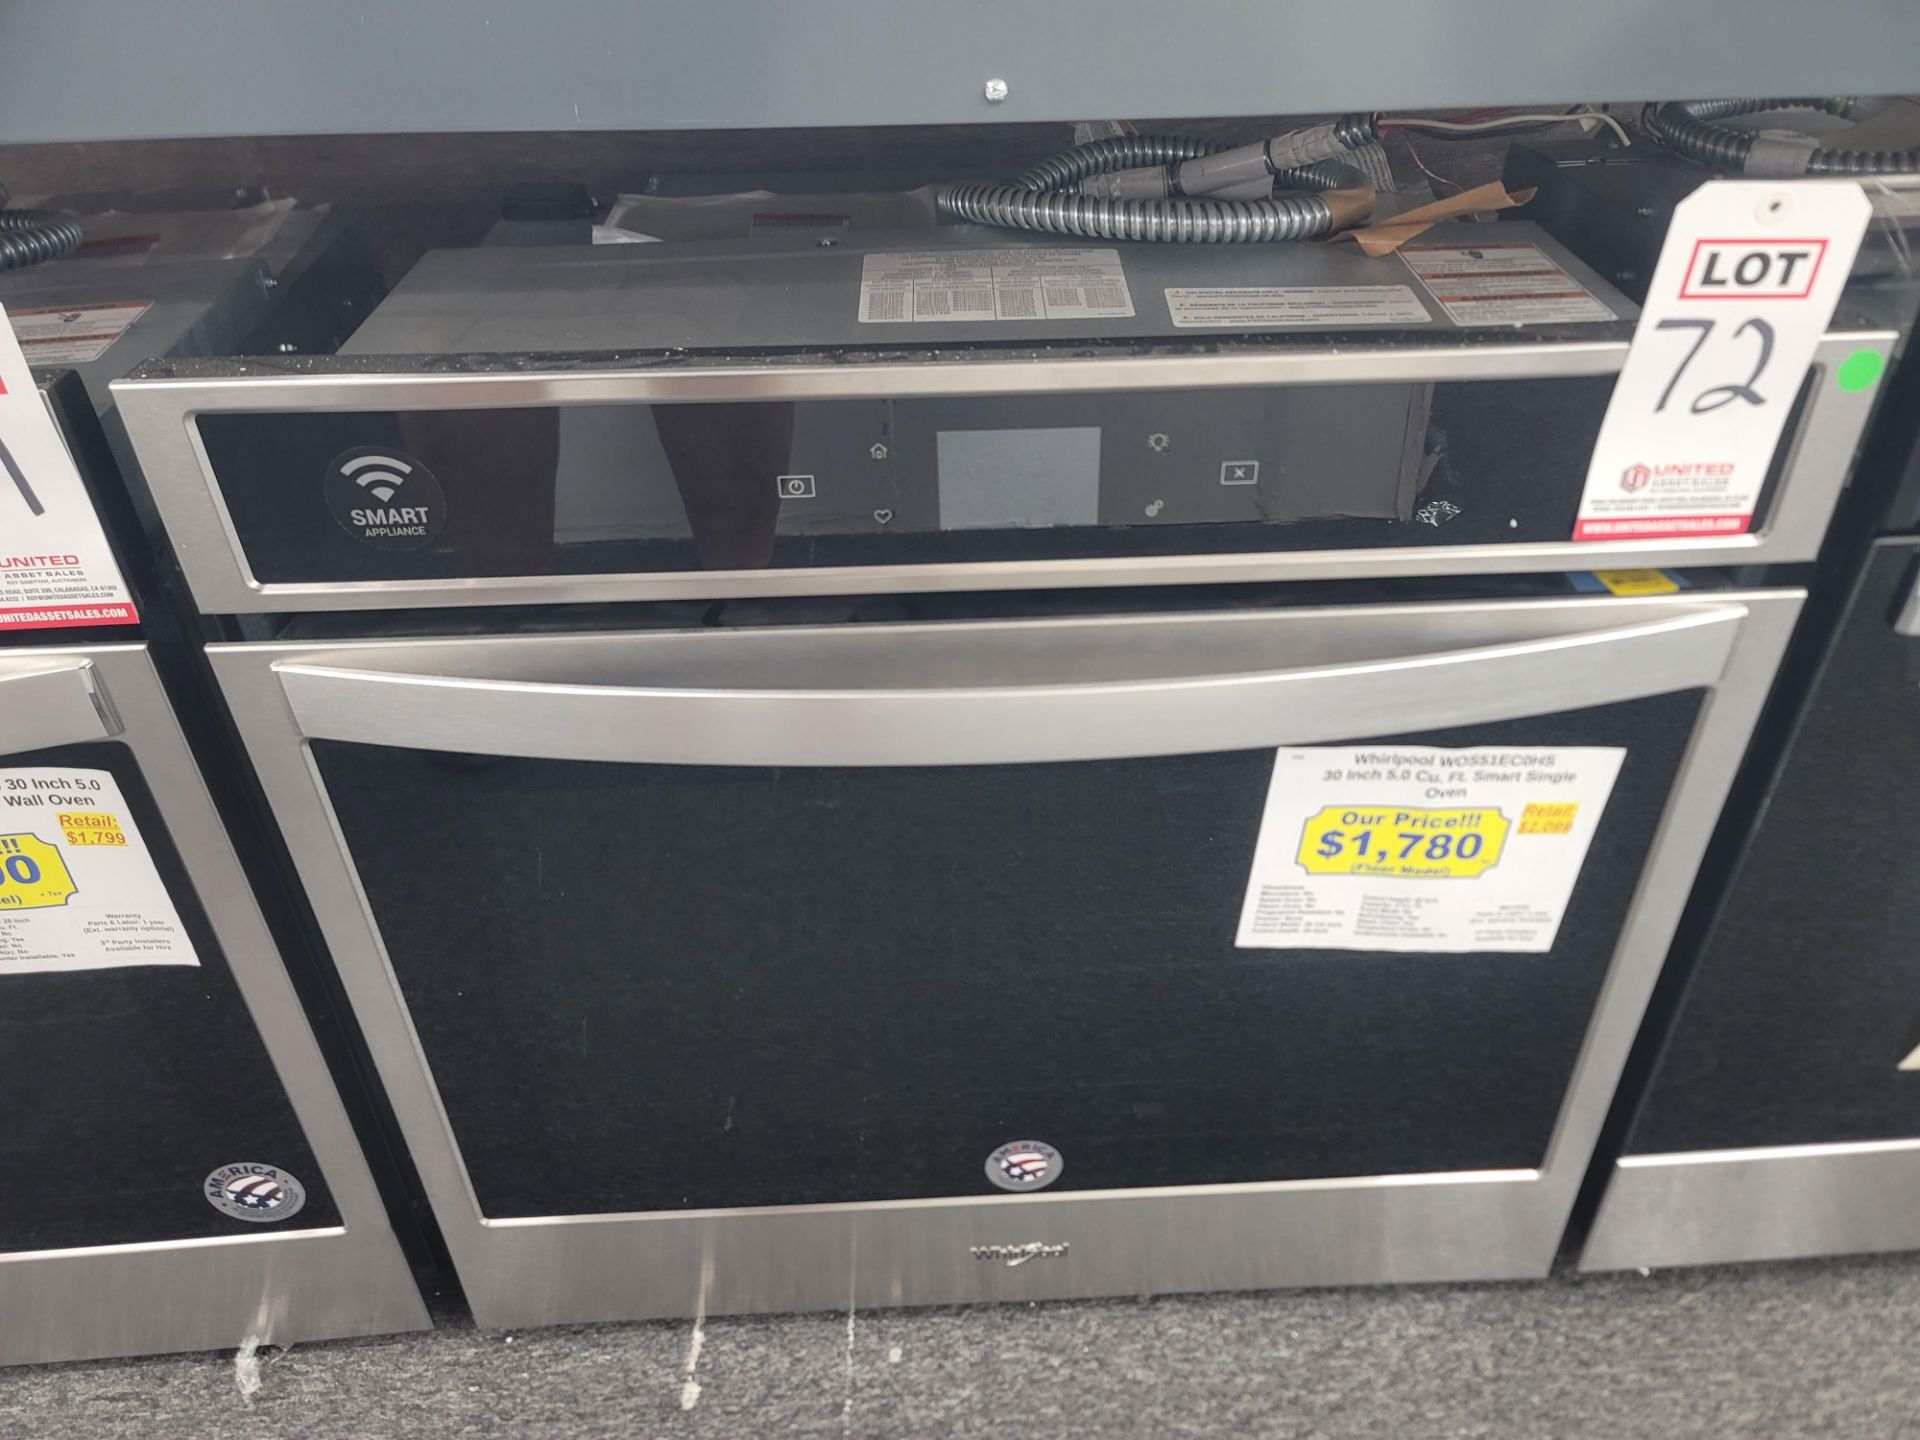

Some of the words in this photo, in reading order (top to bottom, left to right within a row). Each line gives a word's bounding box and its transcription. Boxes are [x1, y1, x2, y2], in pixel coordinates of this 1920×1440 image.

[1700, 252, 1809, 286] LOT
[1655, 318, 1775, 414] 72
[1654, 463, 1735, 476] UNITED
[350, 507, 429, 526] SMART
[365, 526, 427, 538] APPLIANCE
[0, 555, 80, 568] UNITED
[1354, 753, 1435, 767] Whirlpool
[1322, 770, 1342, 782] 30
[1388, 770, 1411, 781] 5.0
[1473, 770, 1521, 783] Smart
[1525, 770, 1577, 784] Single
[5, 778, 27, 790] 30
[31, 778, 71, 790] Inch
[75, 779, 101, 791] 5.0
[1424, 787, 1467, 799] Oven
[3, 795, 44, 807] Wall
[49, 795, 95, 806] Oven
[59, 815, 118, 828] Retail:
[1342, 811, 1385, 826] Our
[1394, 812, 1482, 828] Price!!!
[67, 831, 126, 845] $1,799
[1316, 830, 1483, 863] $1,780
[0, 894, 22, 906] el)
[208, 1164, 277, 1199] AMERICA
